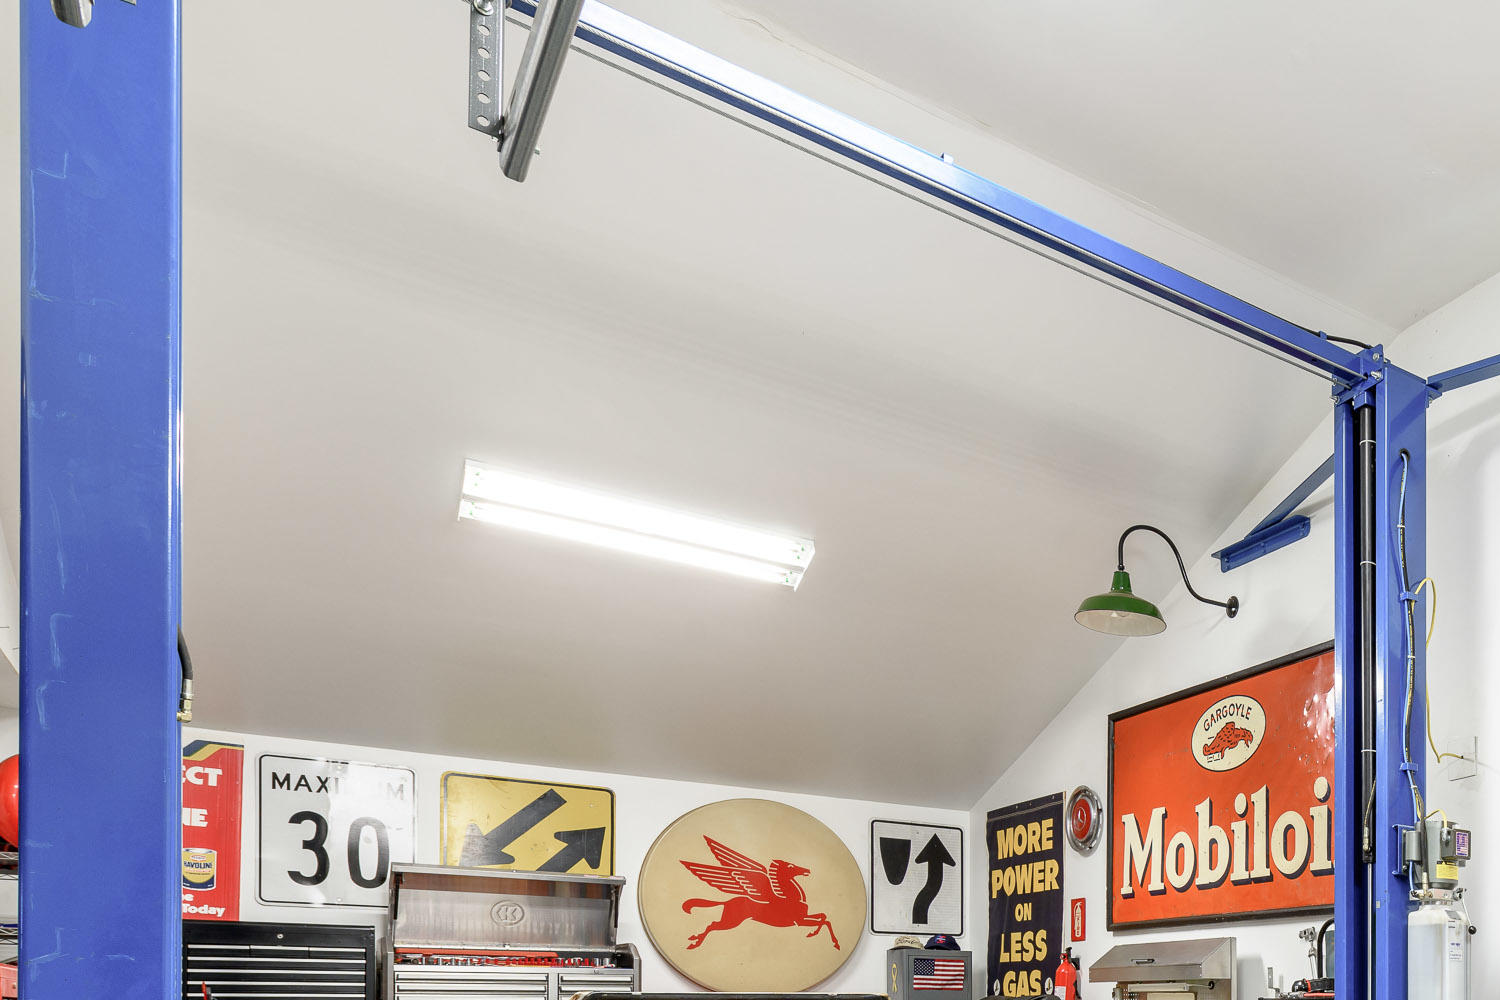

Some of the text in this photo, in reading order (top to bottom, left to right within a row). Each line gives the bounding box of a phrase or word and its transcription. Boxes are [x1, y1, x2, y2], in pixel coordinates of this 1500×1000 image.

[1203, 703, 1253, 732] GARGOYLE
[288, 810, 390, 889] 30
[996, 818, 1054, 860] MORE
[1120, 776, 1335, 899] Mobiloi
[991, 858, 1060, 899] POWER
[1014, 902, 1033, 922] ON
[1000, 929, 1048, 963] LESS
[1002, 969, 1042, 998] GAS
